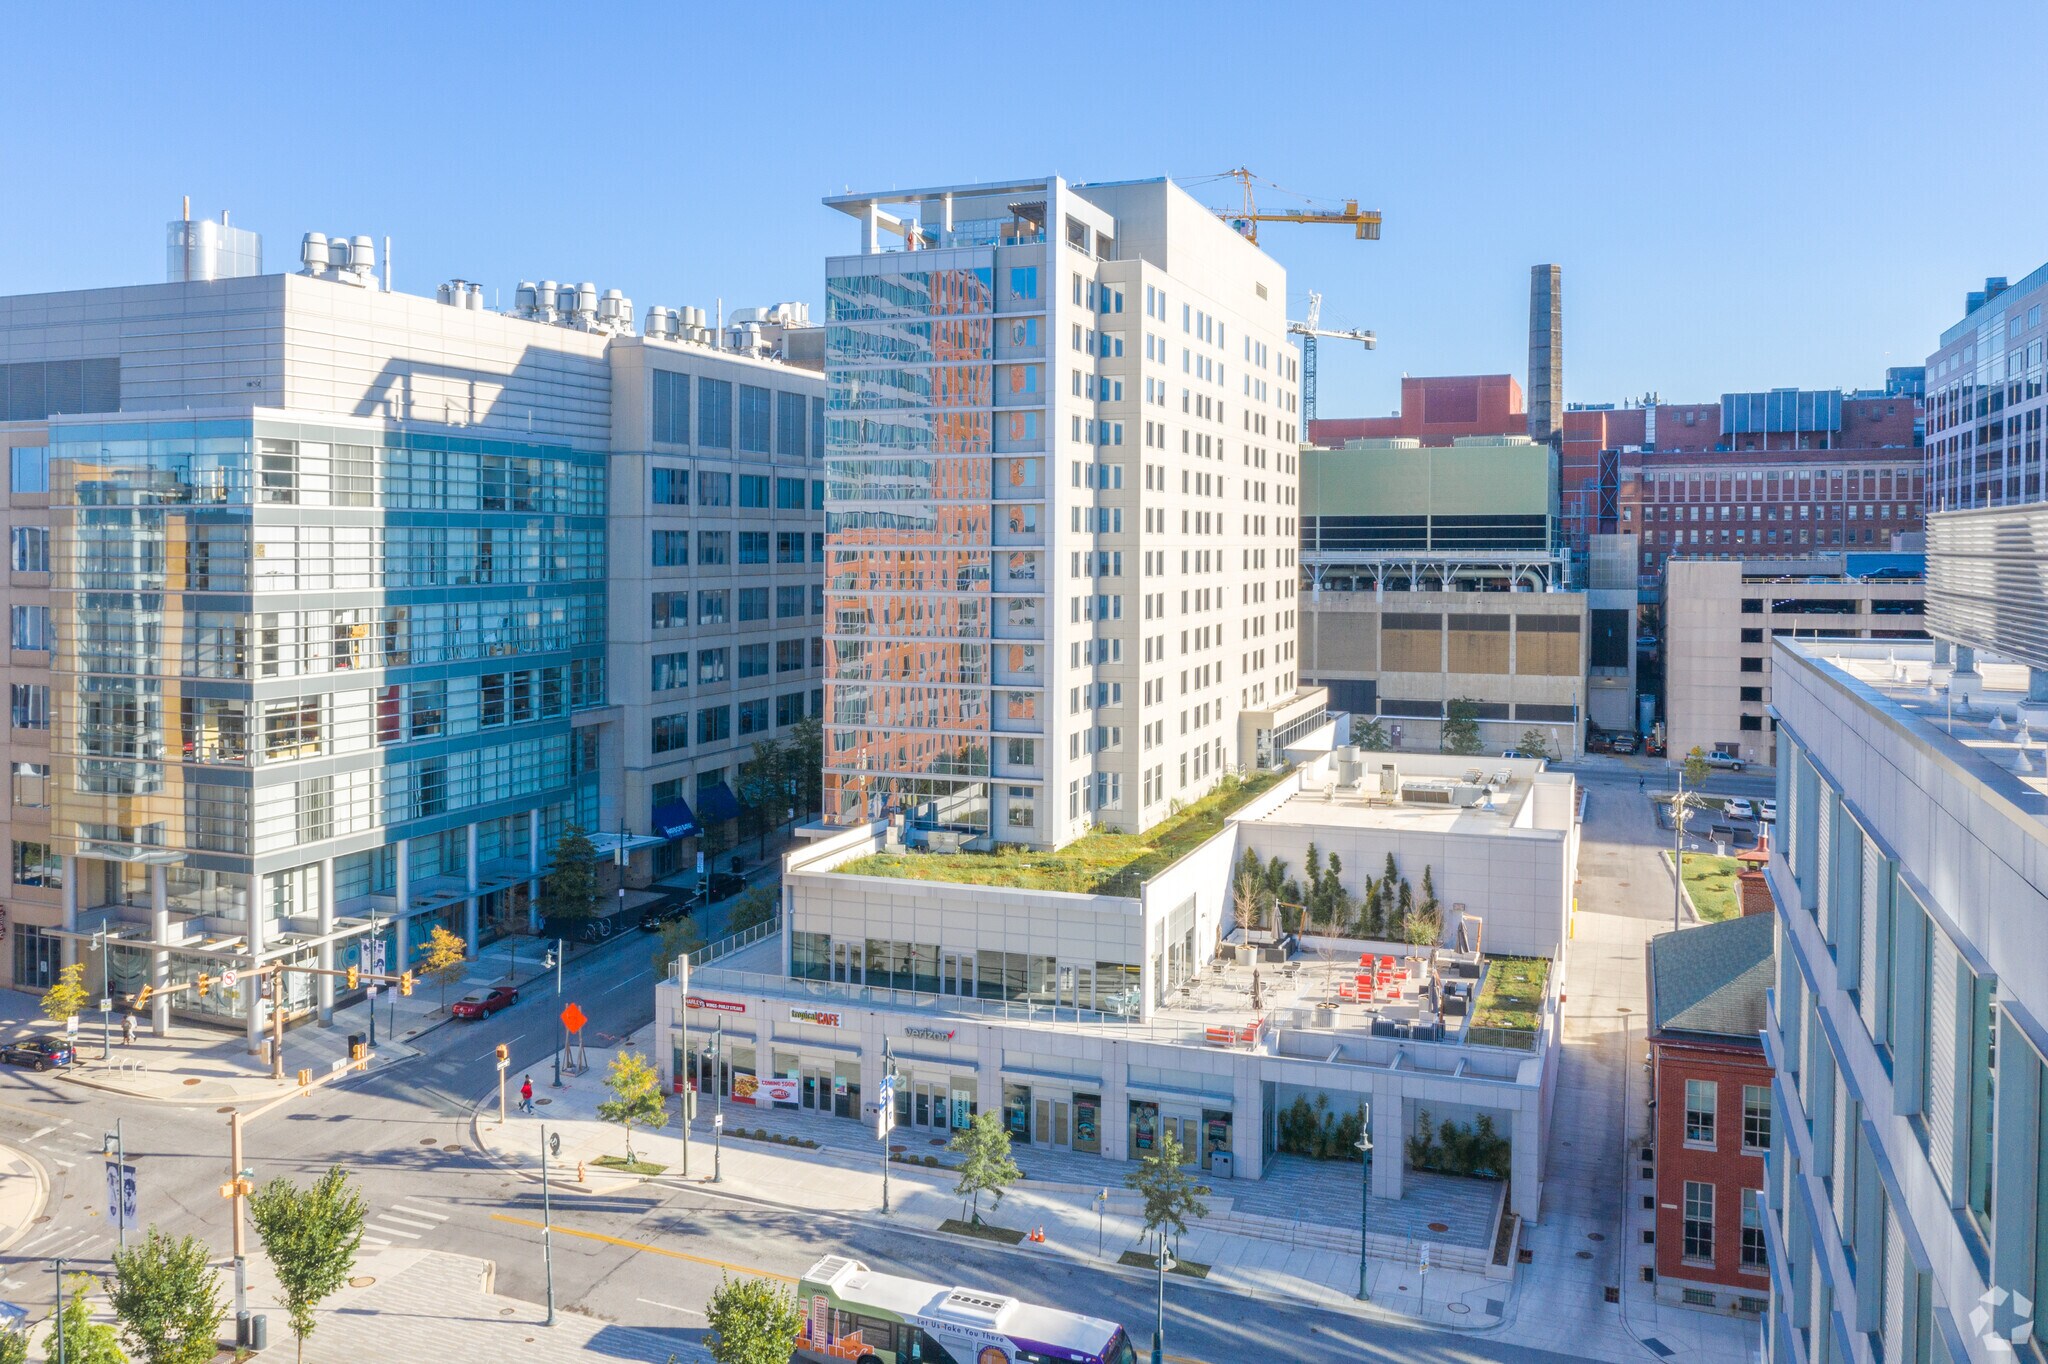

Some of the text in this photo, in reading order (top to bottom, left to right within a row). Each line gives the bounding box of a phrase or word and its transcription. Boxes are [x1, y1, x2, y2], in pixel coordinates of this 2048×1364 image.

[791, 1009, 840, 1027] tropical CAFE
[904, 1027, 949, 1042] verizon
[917, 1318, 1004, 1343] Let Us Take You There
